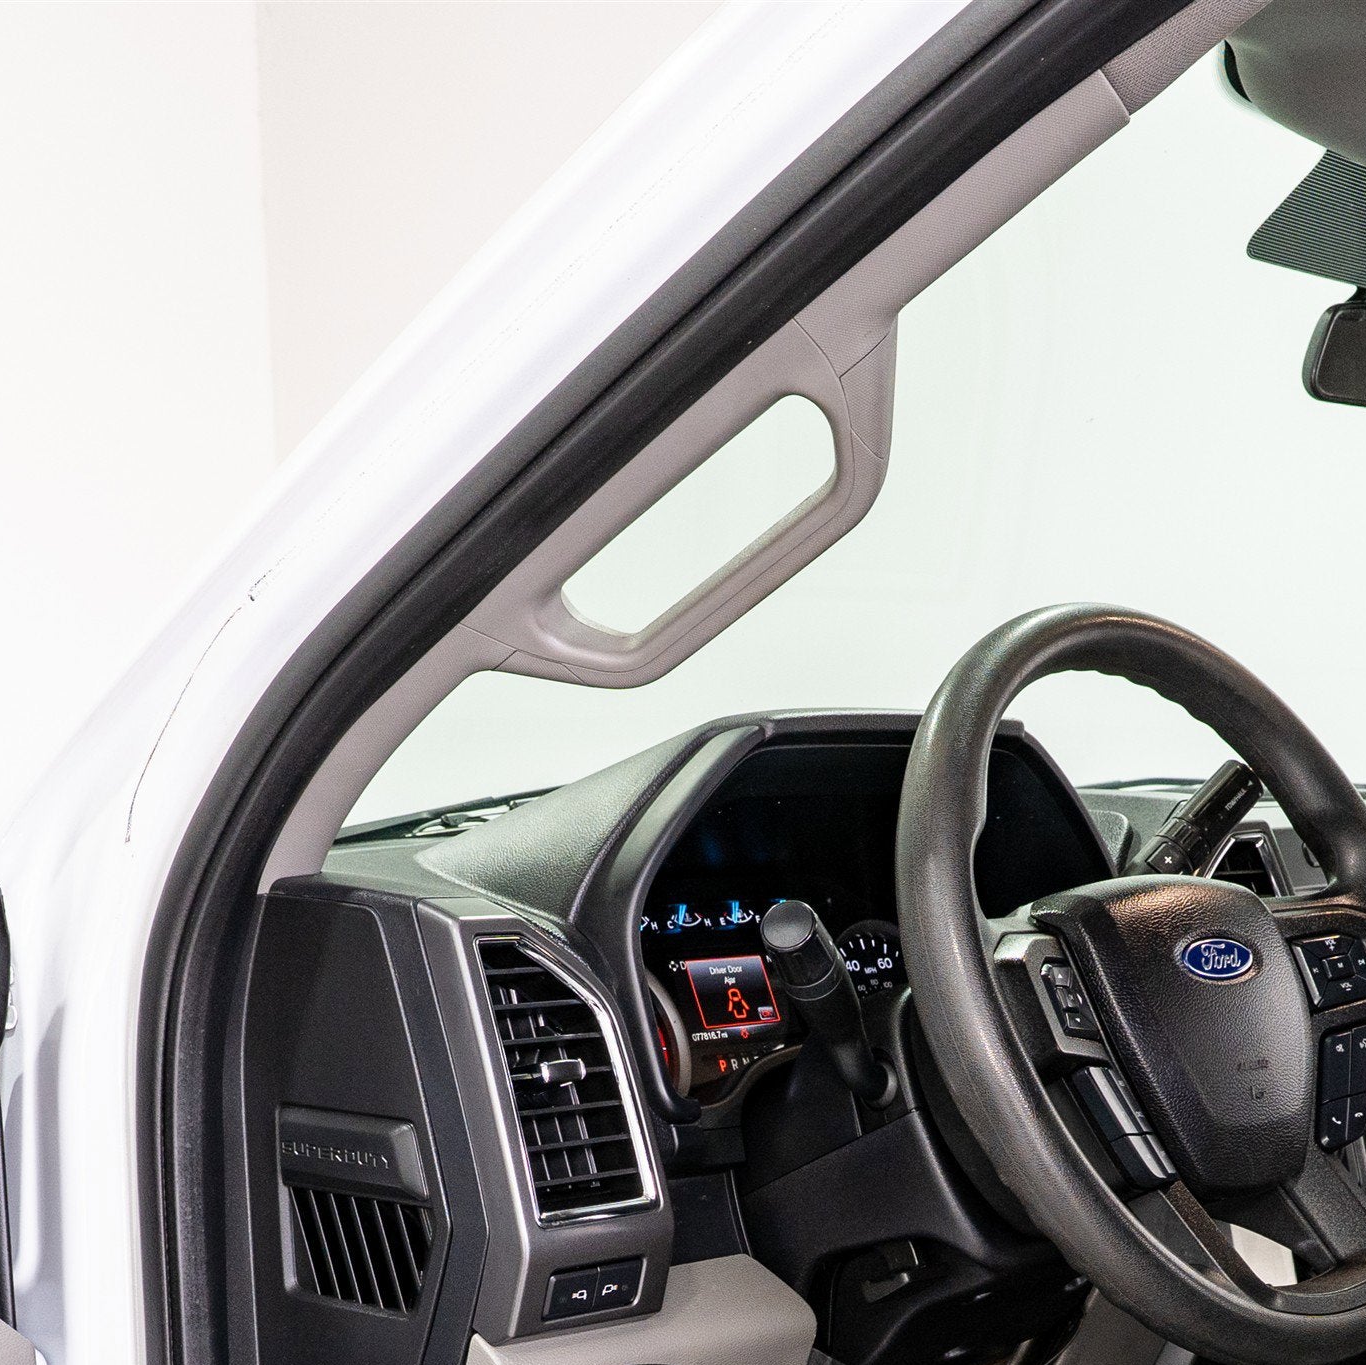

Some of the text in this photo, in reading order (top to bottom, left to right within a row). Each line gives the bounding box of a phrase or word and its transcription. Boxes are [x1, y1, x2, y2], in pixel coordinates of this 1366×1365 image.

[877, 957, 893, 969] 60
[1200, 943, 1241, 971] Ford
[708, 965, 743, 975] Driver Door
[845, 960, 860, 972] 40
[718, 1059, 727, 1072] P
[730, 1058, 739, 1070] R
[281, 1141, 390, 1170] SUPER DUTY
